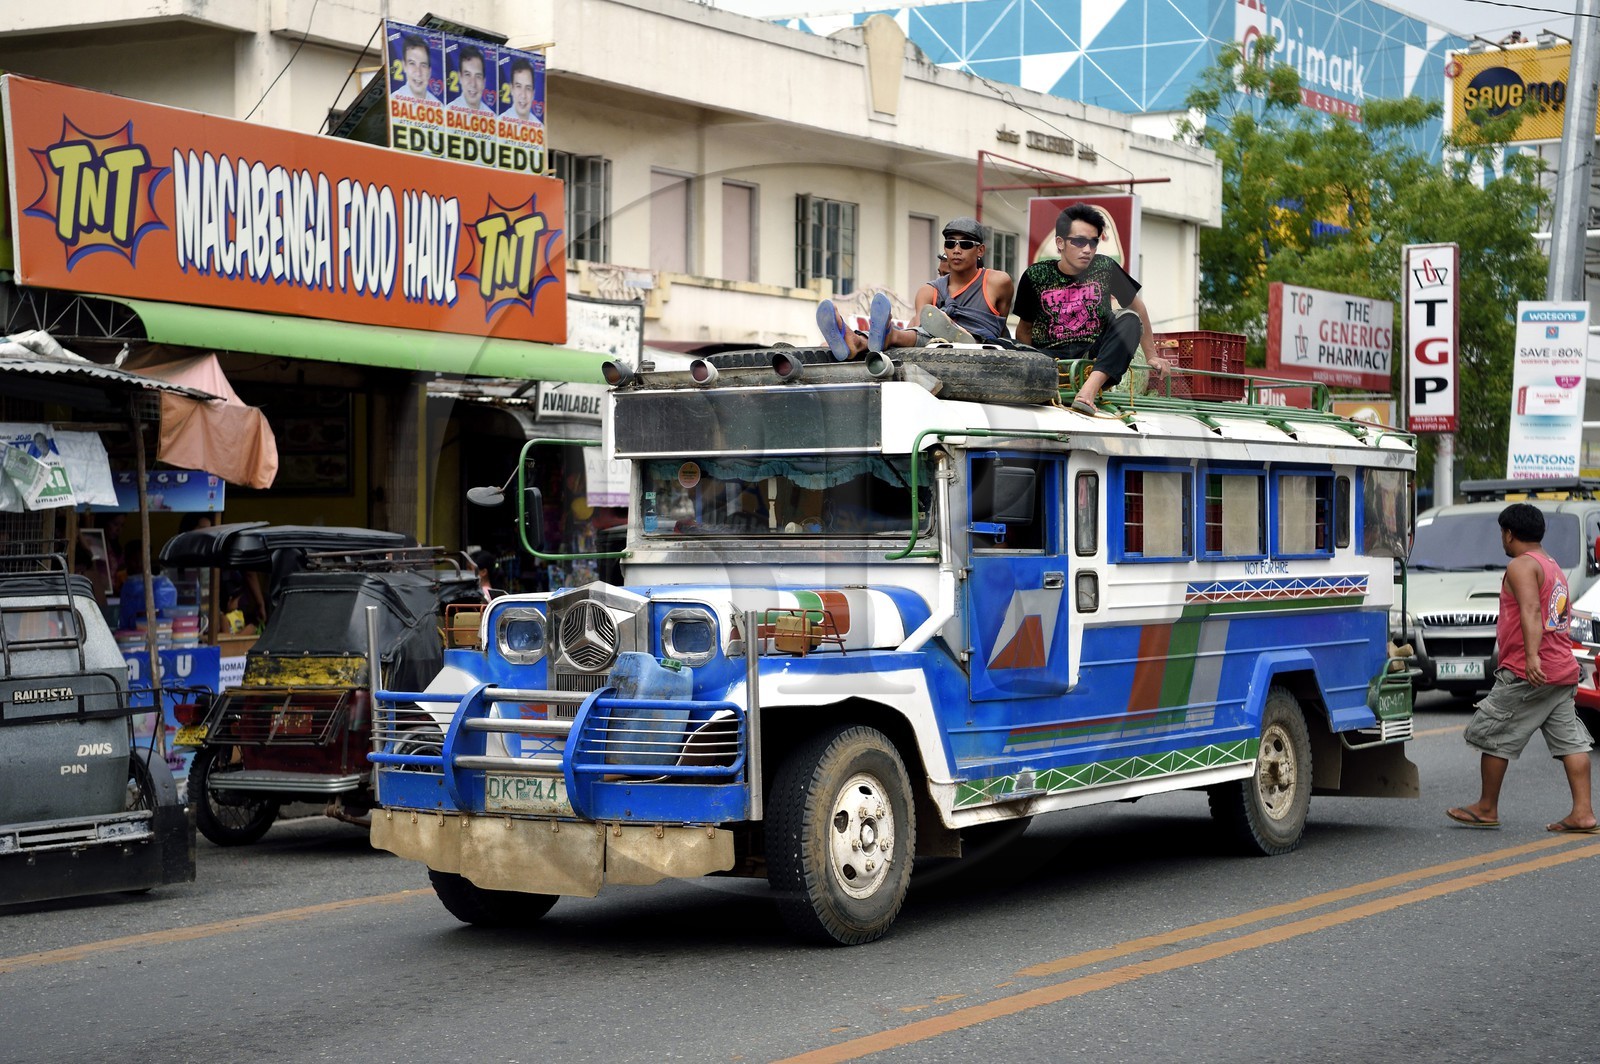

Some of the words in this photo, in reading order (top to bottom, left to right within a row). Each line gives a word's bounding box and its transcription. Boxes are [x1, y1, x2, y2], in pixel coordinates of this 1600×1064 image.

[1270, 16, 1364, 99] Primark
[391, 100, 444, 126] BALGOS
[1315, 94, 1361, 119] CENTER
[446, 110, 497, 136] BALGOS
[498, 121, 544, 145] BALGOS
[392, 124, 444, 156] EDU
[447, 134, 497, 166] EDU
[498, 144, 544, 175] EDU
[47, 141, 151, 248] TNT
[173, 147, 334, 294] MACABENGA
[337, 177, 398, 299] FOOD
[403, 188, 460, 306] HAUZ
[474, 212, 550, 300] TNT
[1042, 284, 1099, 307] TRIBAL
[1291, 292, 1313, 316] TGP
[1345, 301, 1370, 323] THE
[1529, 312, 1577, 321] watsons
[1319, 319, 1391, 350] GENERICS
[1318, 344, 1389, 370] PHARMACY
[1414, 299, 1449, 405] TGP
[1520, 348, 1550, 358] SAVE
[1558, 348, 1583, 358] 80%
[542, 392, 600, 414] AVAILABLE
[1260, 388, 1287, 406] Plus
[587, 459, 630, 474] AVON
[1513, 454, 1576, 465] WATSONS
[1513, 472, 1541, 480] OPENS
[1244, 562, 1259, 576] NOT
[1260, 561, 1275, 574] FOR
[1274, 561, 1290, 575] HIRE
[1463, 663, 1481, 673] 493
[13, 687, 75, 704] BAUTISTA
[77, 743, 113, 757] DWS
[60, 763, 88, 776] PIN
